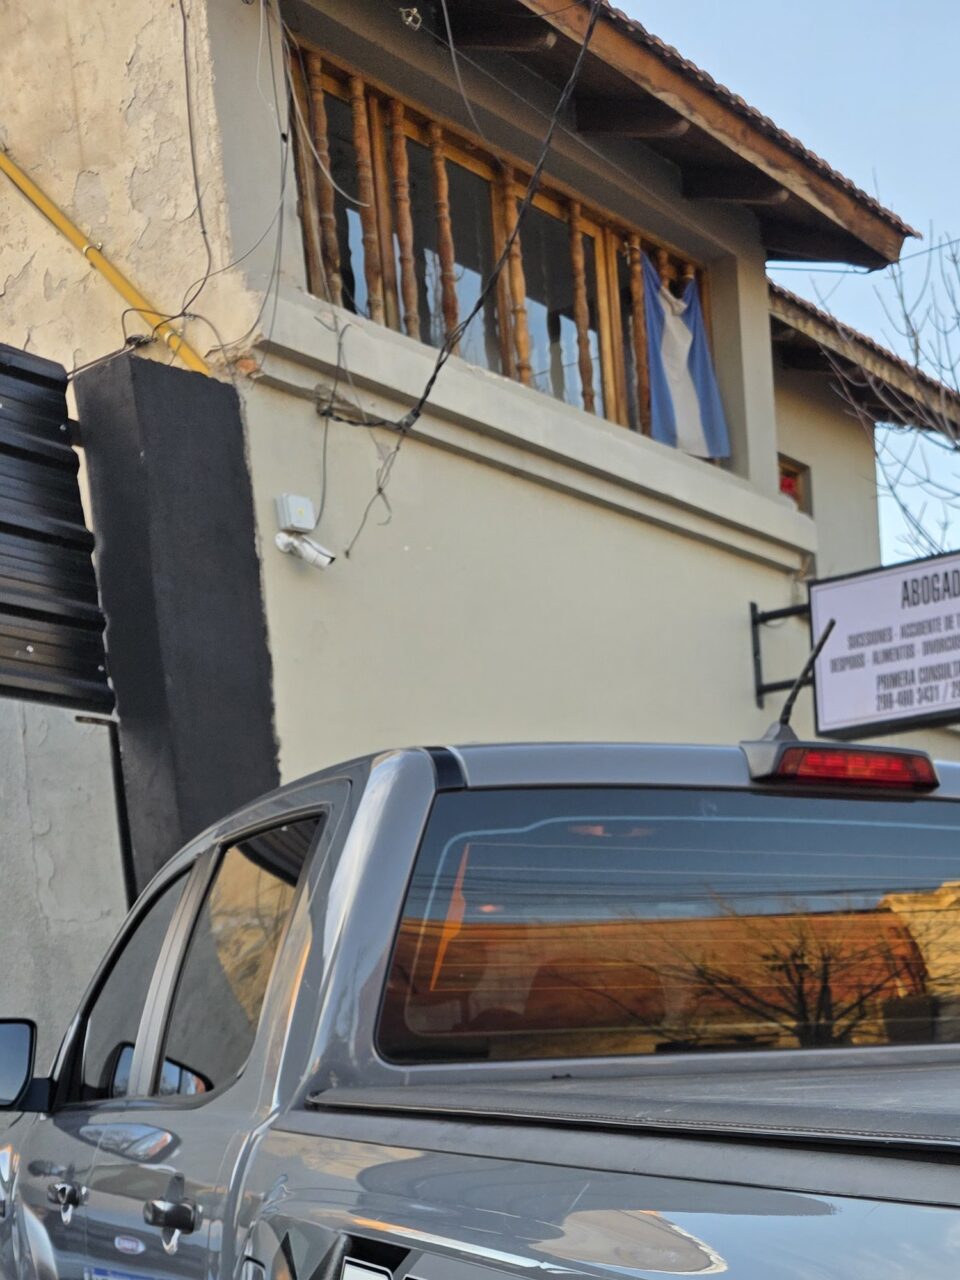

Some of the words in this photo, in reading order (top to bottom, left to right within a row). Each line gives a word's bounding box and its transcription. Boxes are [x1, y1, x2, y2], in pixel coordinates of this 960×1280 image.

[900, 616, 942, 639] ACCIDENTE
[944, 614, 954, 631] DE
[876, 668, 916, 692] PRIMERA
